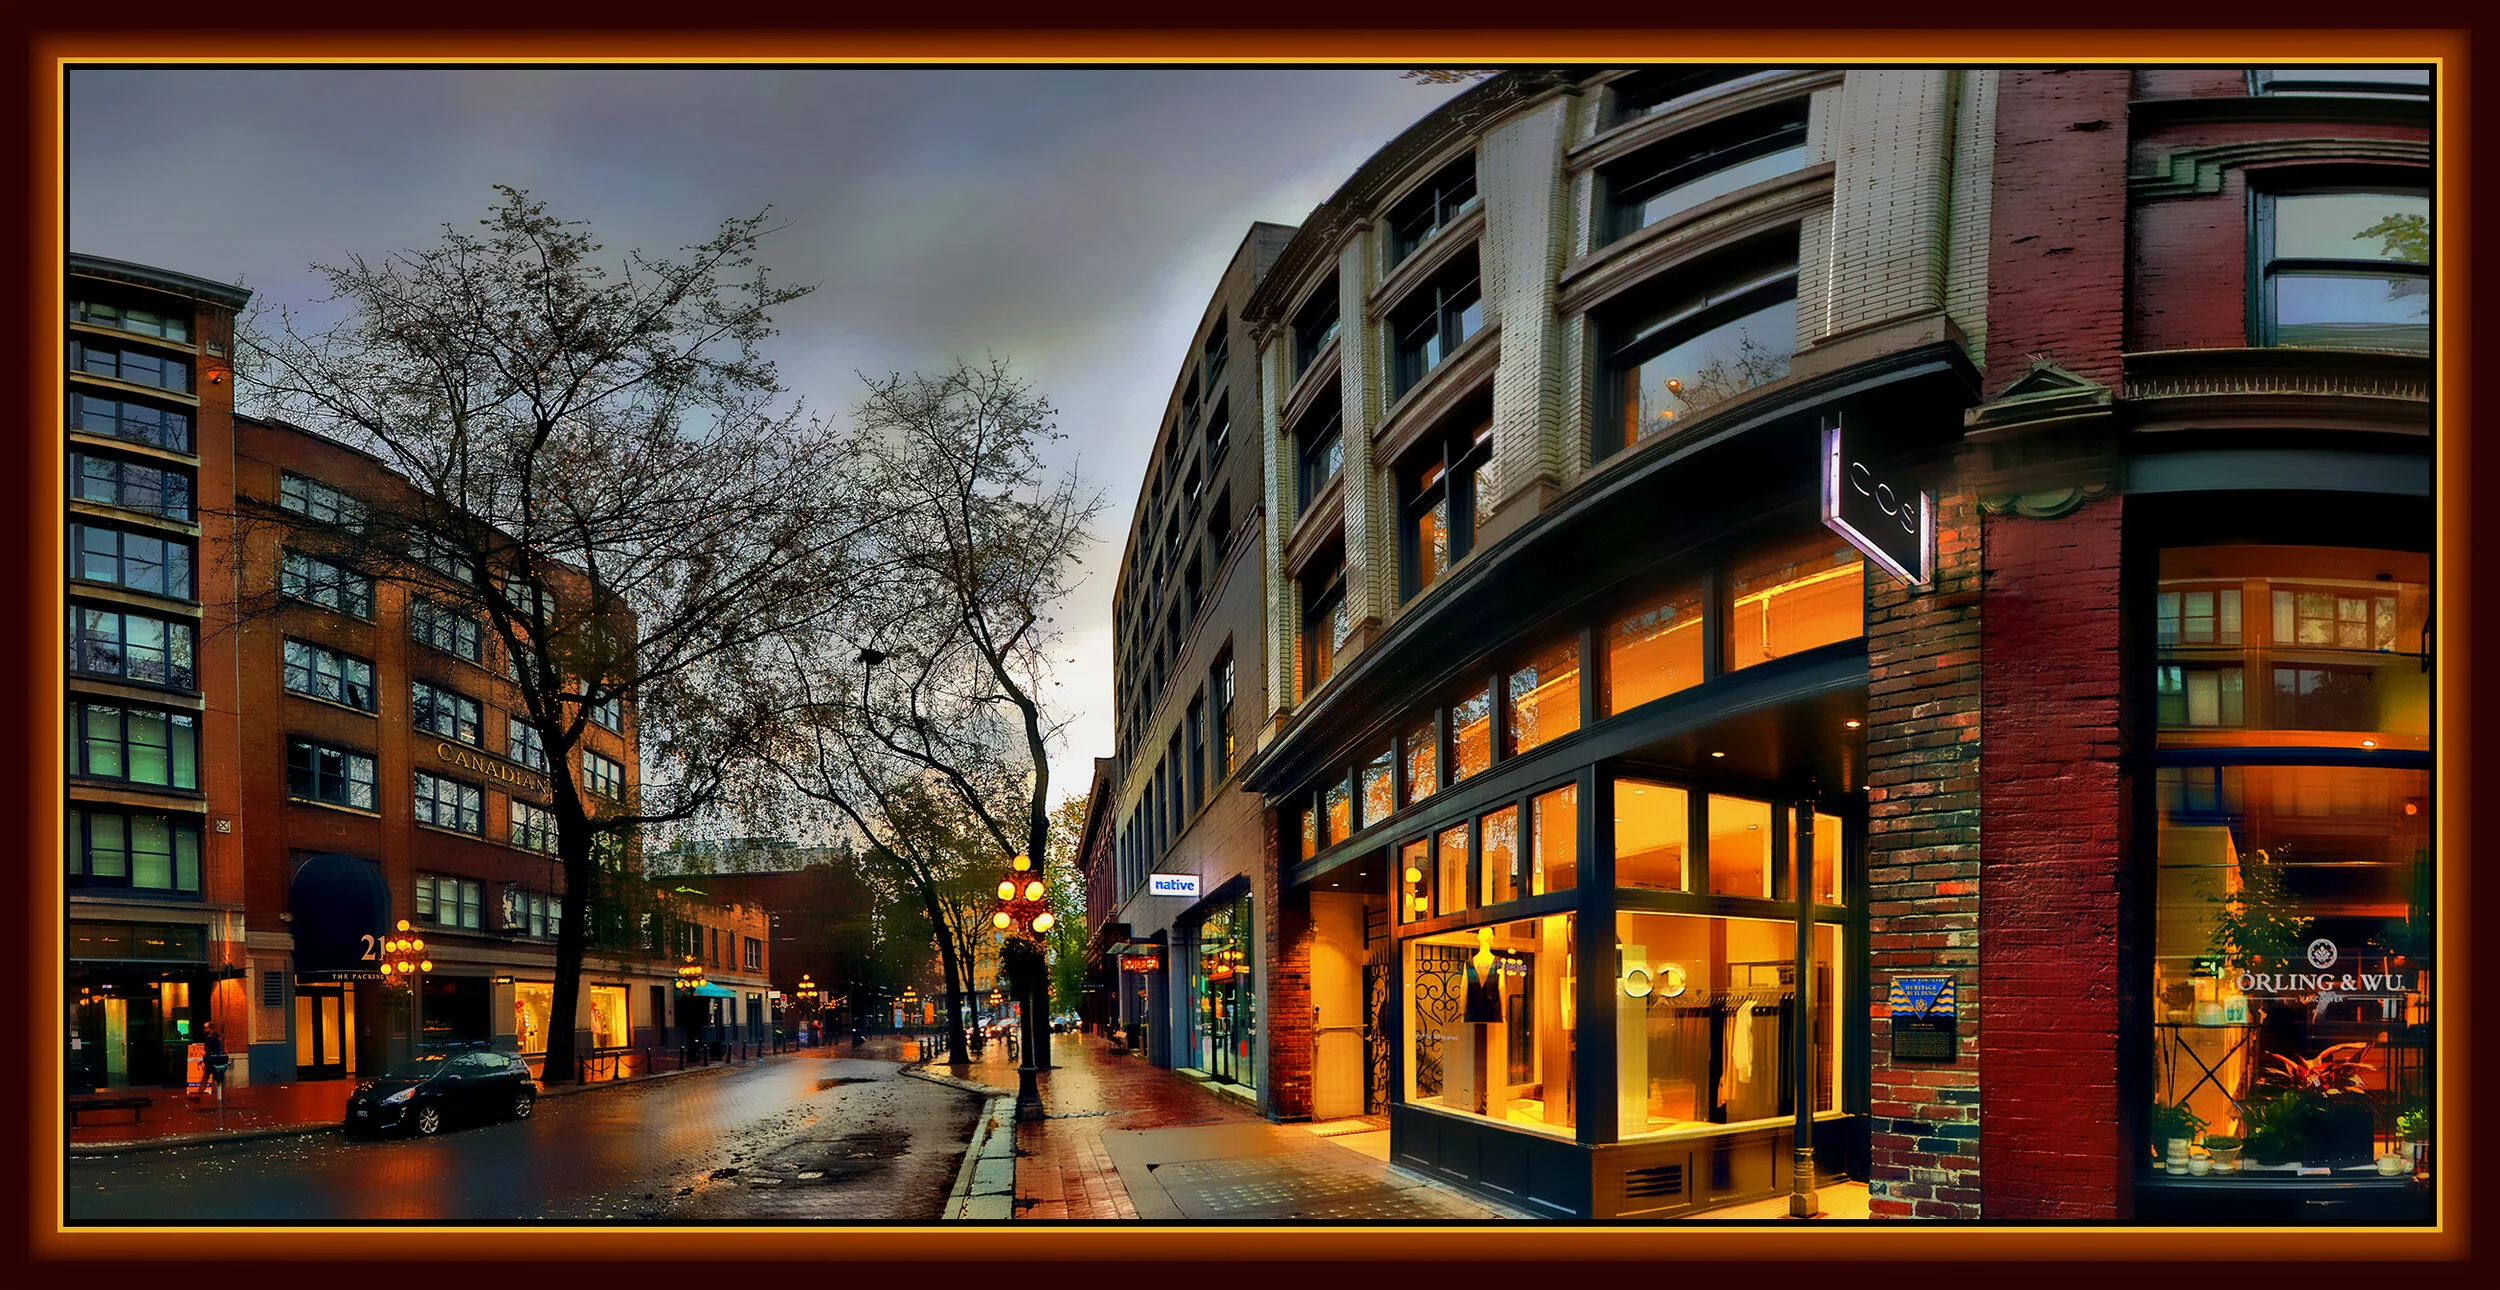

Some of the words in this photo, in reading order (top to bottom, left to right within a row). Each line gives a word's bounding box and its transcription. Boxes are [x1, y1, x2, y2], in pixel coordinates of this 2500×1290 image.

[1849, 461, 1915, 535] COS
[436, 742, 549, 796] CANADIAN
[1155, 879, 1195, 891] native
[2236, 969, 2335, 993] ÖRLING
[2340, 974, 2358, 991] &
[2300, 995, 2344, 1003] VANCOUVER
